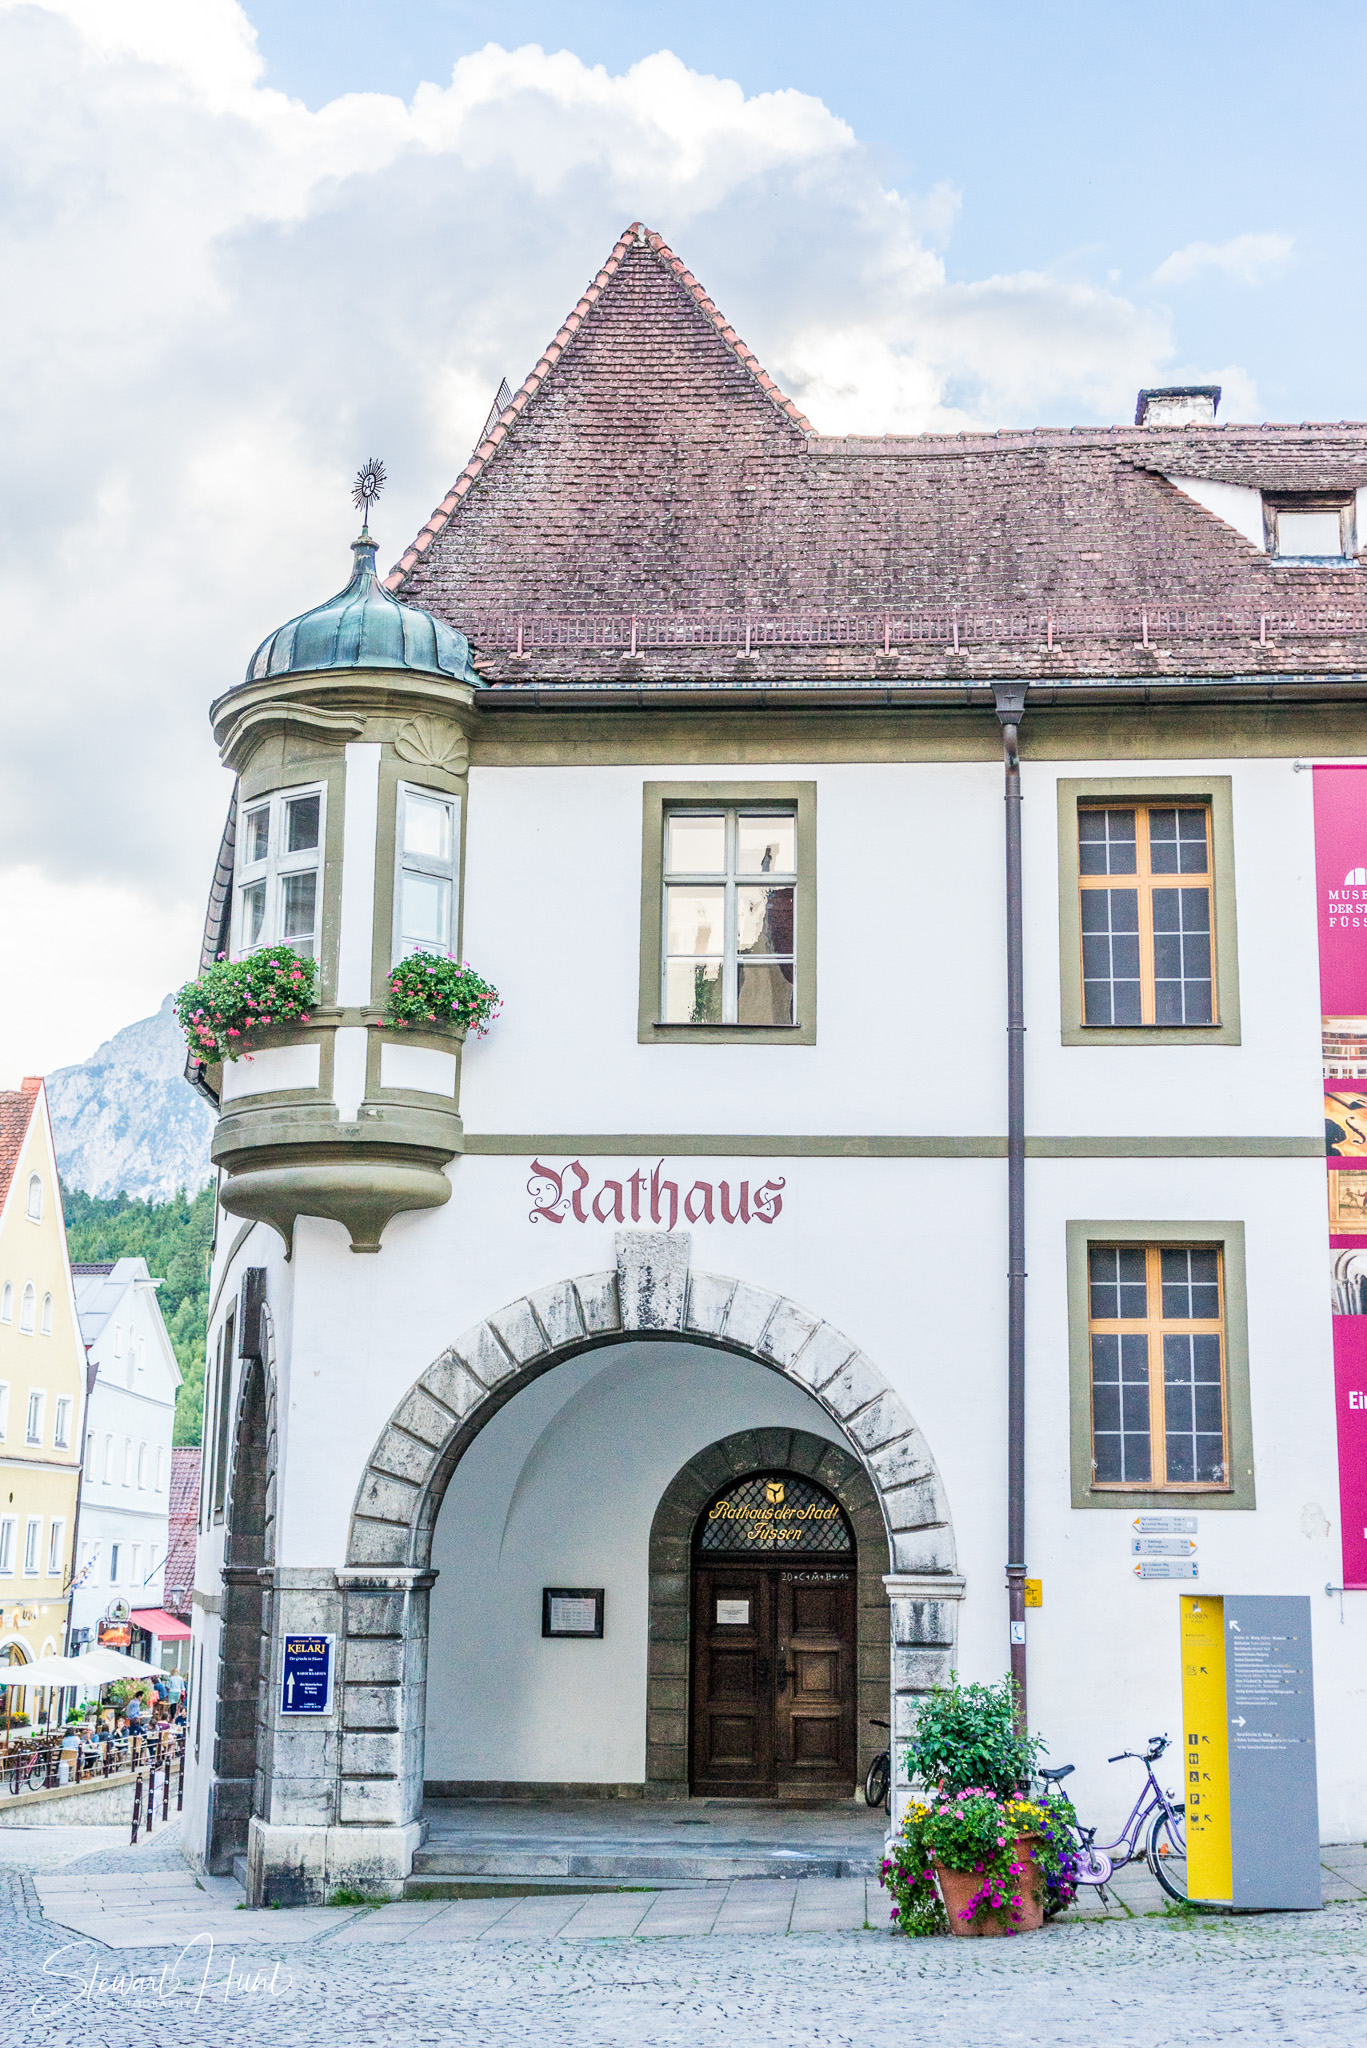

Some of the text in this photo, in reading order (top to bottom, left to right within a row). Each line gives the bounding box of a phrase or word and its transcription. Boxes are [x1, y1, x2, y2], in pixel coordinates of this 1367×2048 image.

[1329, 904, 1353, 913] DER
[526, 1158, 786, 1232] Rathaus
[709, 1501, 839, 1519] Rathaus der Stadt
[747, 1522, 802, 1540] Füssen
[288, 1644, 326, 1655] KELARI
